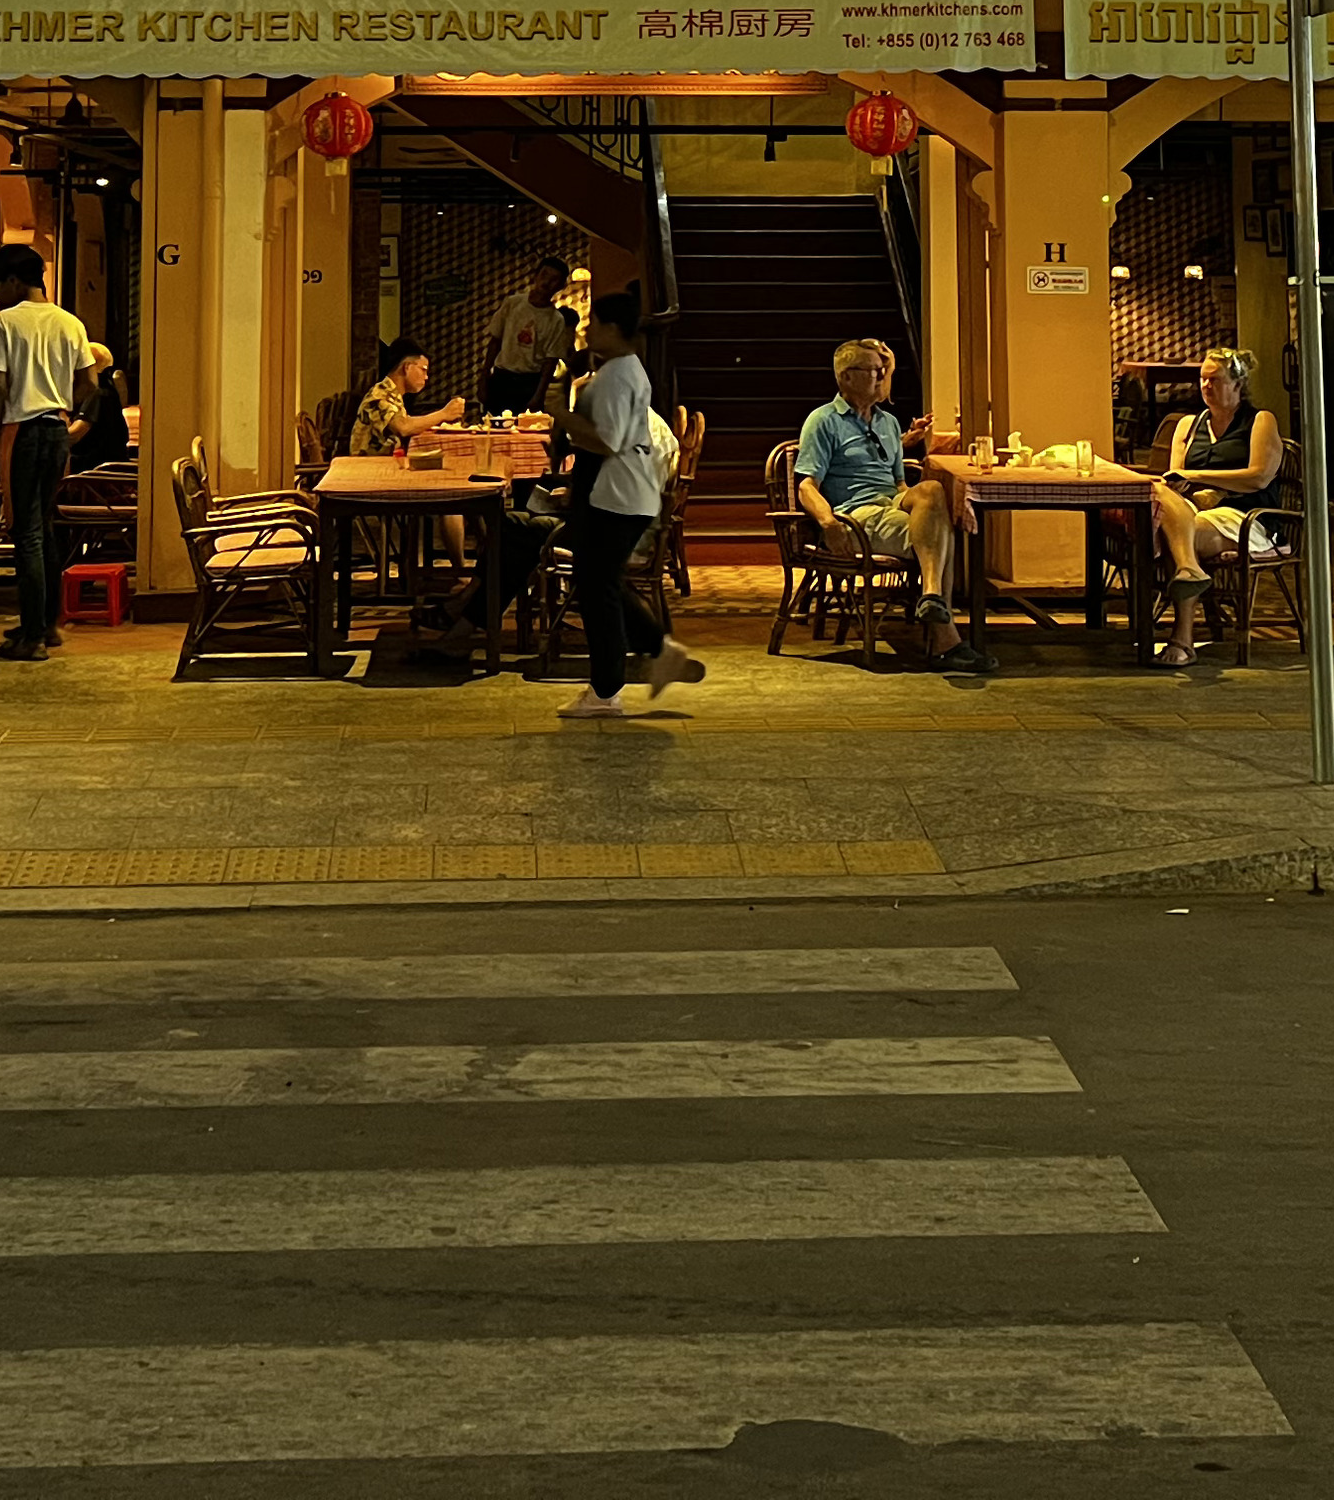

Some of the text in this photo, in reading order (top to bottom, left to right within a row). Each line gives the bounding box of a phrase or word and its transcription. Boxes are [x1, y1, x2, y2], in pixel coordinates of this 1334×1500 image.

[841, 2, 1024, 18] www.khmerkitchens.com
[136, 10, 320, 43] KITCHEN
[332, 8, 610, 43] RESTAURANT
[636, 8, 817, 40] 高棉厨房
[842, 31, 1026, 51] Tel: +855 (0)12 763 468
[157, 244, 180, 265] G
[1043, 242, 1067, 263] H
